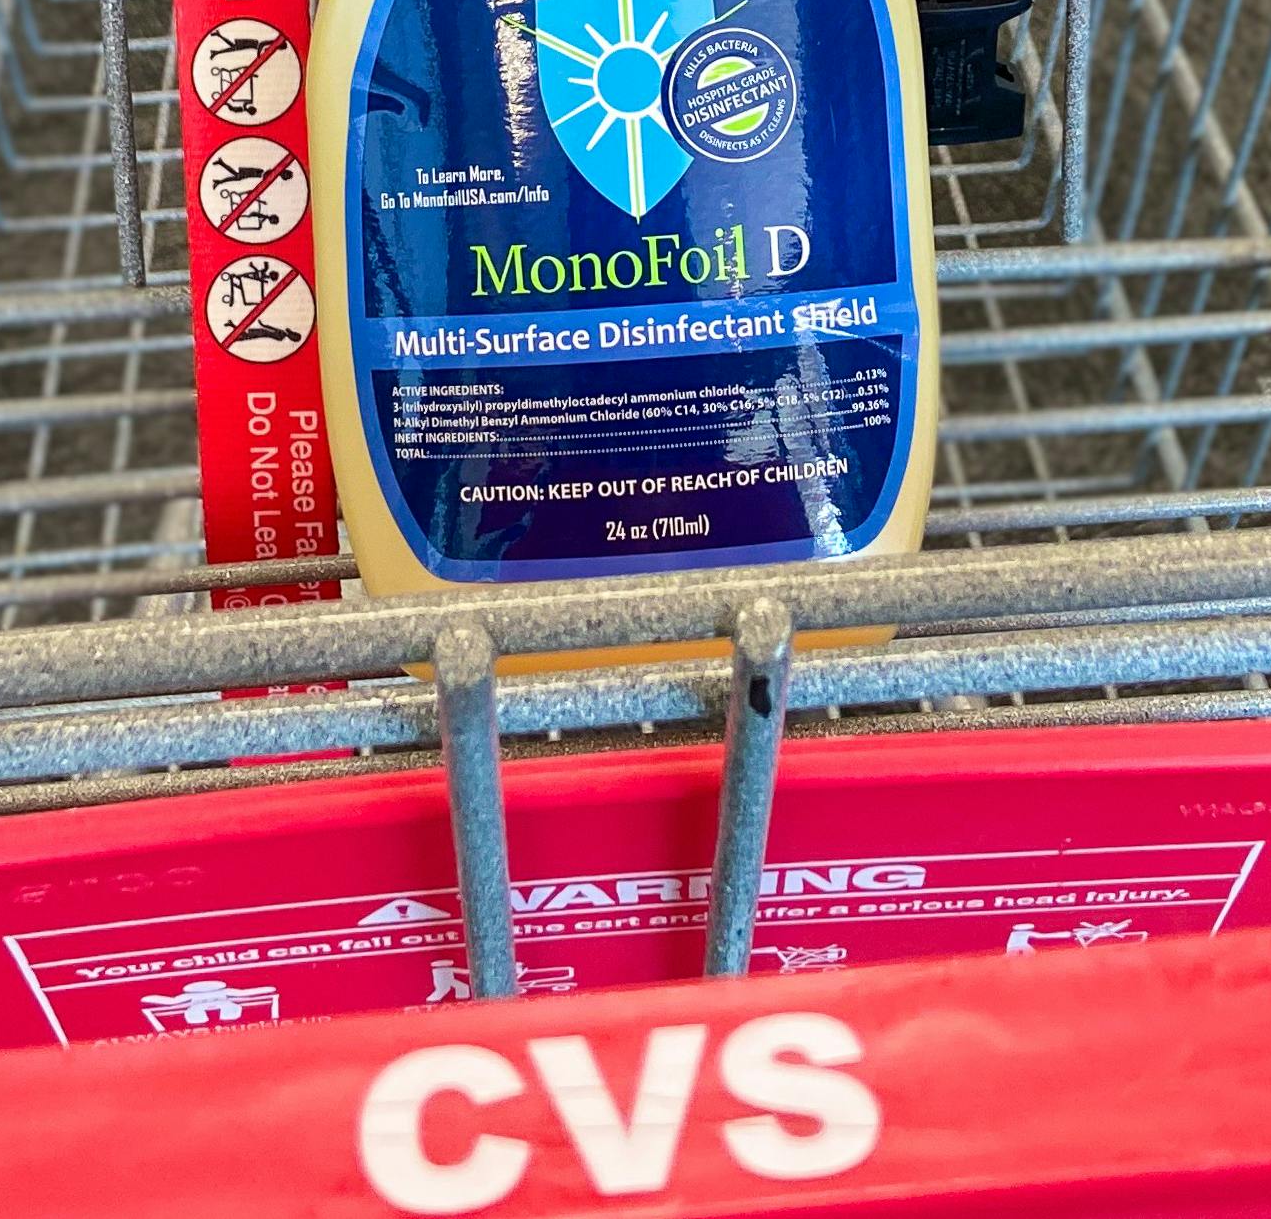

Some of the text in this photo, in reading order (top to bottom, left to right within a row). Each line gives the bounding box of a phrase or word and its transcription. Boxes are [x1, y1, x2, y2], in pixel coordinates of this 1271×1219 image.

[684, 39, 759, 79] KILLS BACTERIA
[682, 74, 788, 128] DISINFECTANT
[687, 66, 777, 110] HOSPITAL GRADE
[699, 98, 787, 151] DISINFECTS AS IT CLEANS
[415, 165, 505, 185] To Learn More,
[381, 185, 550, 210] Go To MonofoilUSA.com/Info
[469, 224, 811, 297] MonoFoil D
[394, 296, 878, 357] Multi-Surface Disinfectant Shield
[392, 384, 504, 398] ACTIVE INGREDIENTS:
[432, 414, 479, 428] Dimethyl
[481, 411, 518, 427] Benzyl
[520, 412, 588, 425] Ammonium
[590, 408, 640, 422] Chloride
[642, 406, 672, 421] (60%
[674, 403, 700, 417] C14,
[702, 402, 728, 415] 30%
[757, 396, 775, 409] 5%
[803, 392, 819, 403] 5%
[630, 389, 697, 403] ammonium
[246, 392, 277, 436] Do
[394, 399, 889, 444] INERT INGREDIENTS: 99.36%
[863, 414, 891, 427] 100%
[250, 447, 280, 500] Not
[288, 411, 318, 512] Please
[460, 458, 849, 503] CAUTION: KEEP OUT OF REACH OF CHILDREN
[606, 514, 710, 541] 24 oz (710ml)
[76, 959, 166, 980] Your
[172, 948, 260, 969] child
[266, 942, 332, 959] can
[338, 935, 392, 952] fall
[400, 930, 459, 946] out
[574, 915, 640, 931] cart
[829, 904, 849, 916] a
[858, 897, 984, 915] serious
[994, 892, 1077, 908] head
[358, 1011, 881, 1214] CVS
